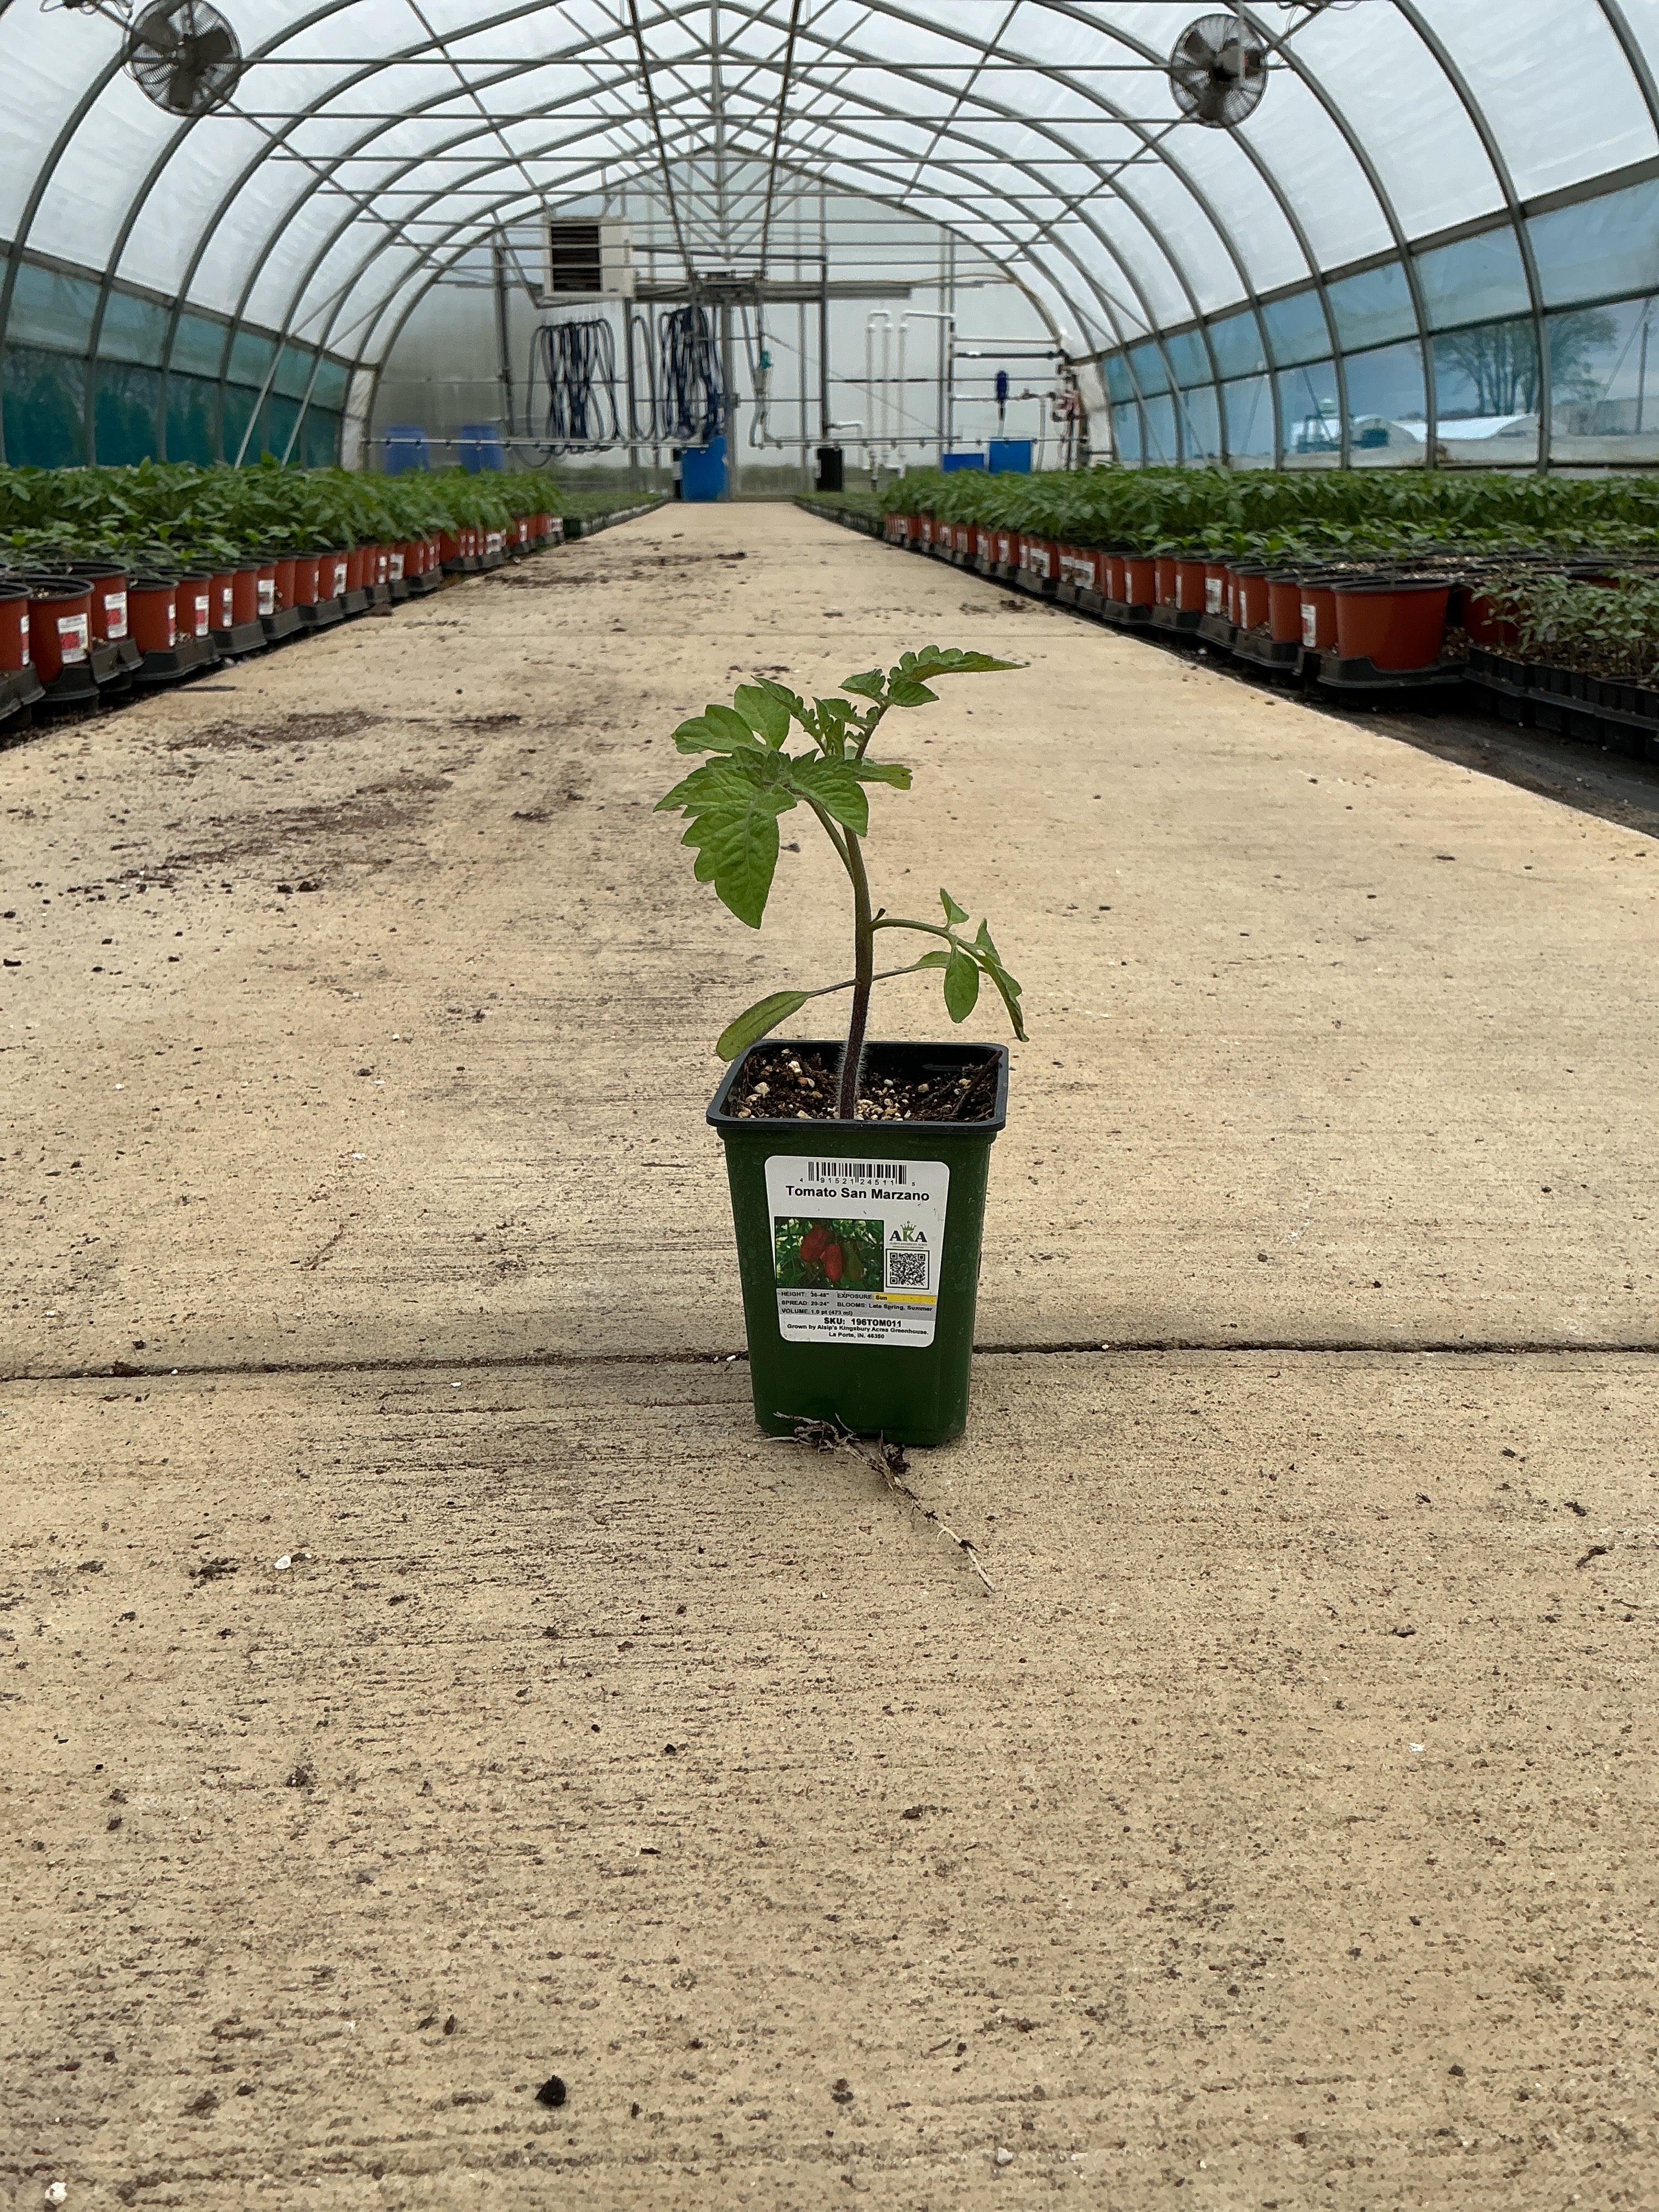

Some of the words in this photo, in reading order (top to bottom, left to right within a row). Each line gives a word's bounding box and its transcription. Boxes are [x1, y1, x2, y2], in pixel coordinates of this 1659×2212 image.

[785, 1186, 837, 1197] Tomato
[840, 1187, 867, 1198] San
[871, 1189, 929, 1201] Marzano
[889, 1230, 927, 1243] AKA
[824, 1317, 845, 1325] SKU:
[851, 1318, 901, 1327] 196TOM011
